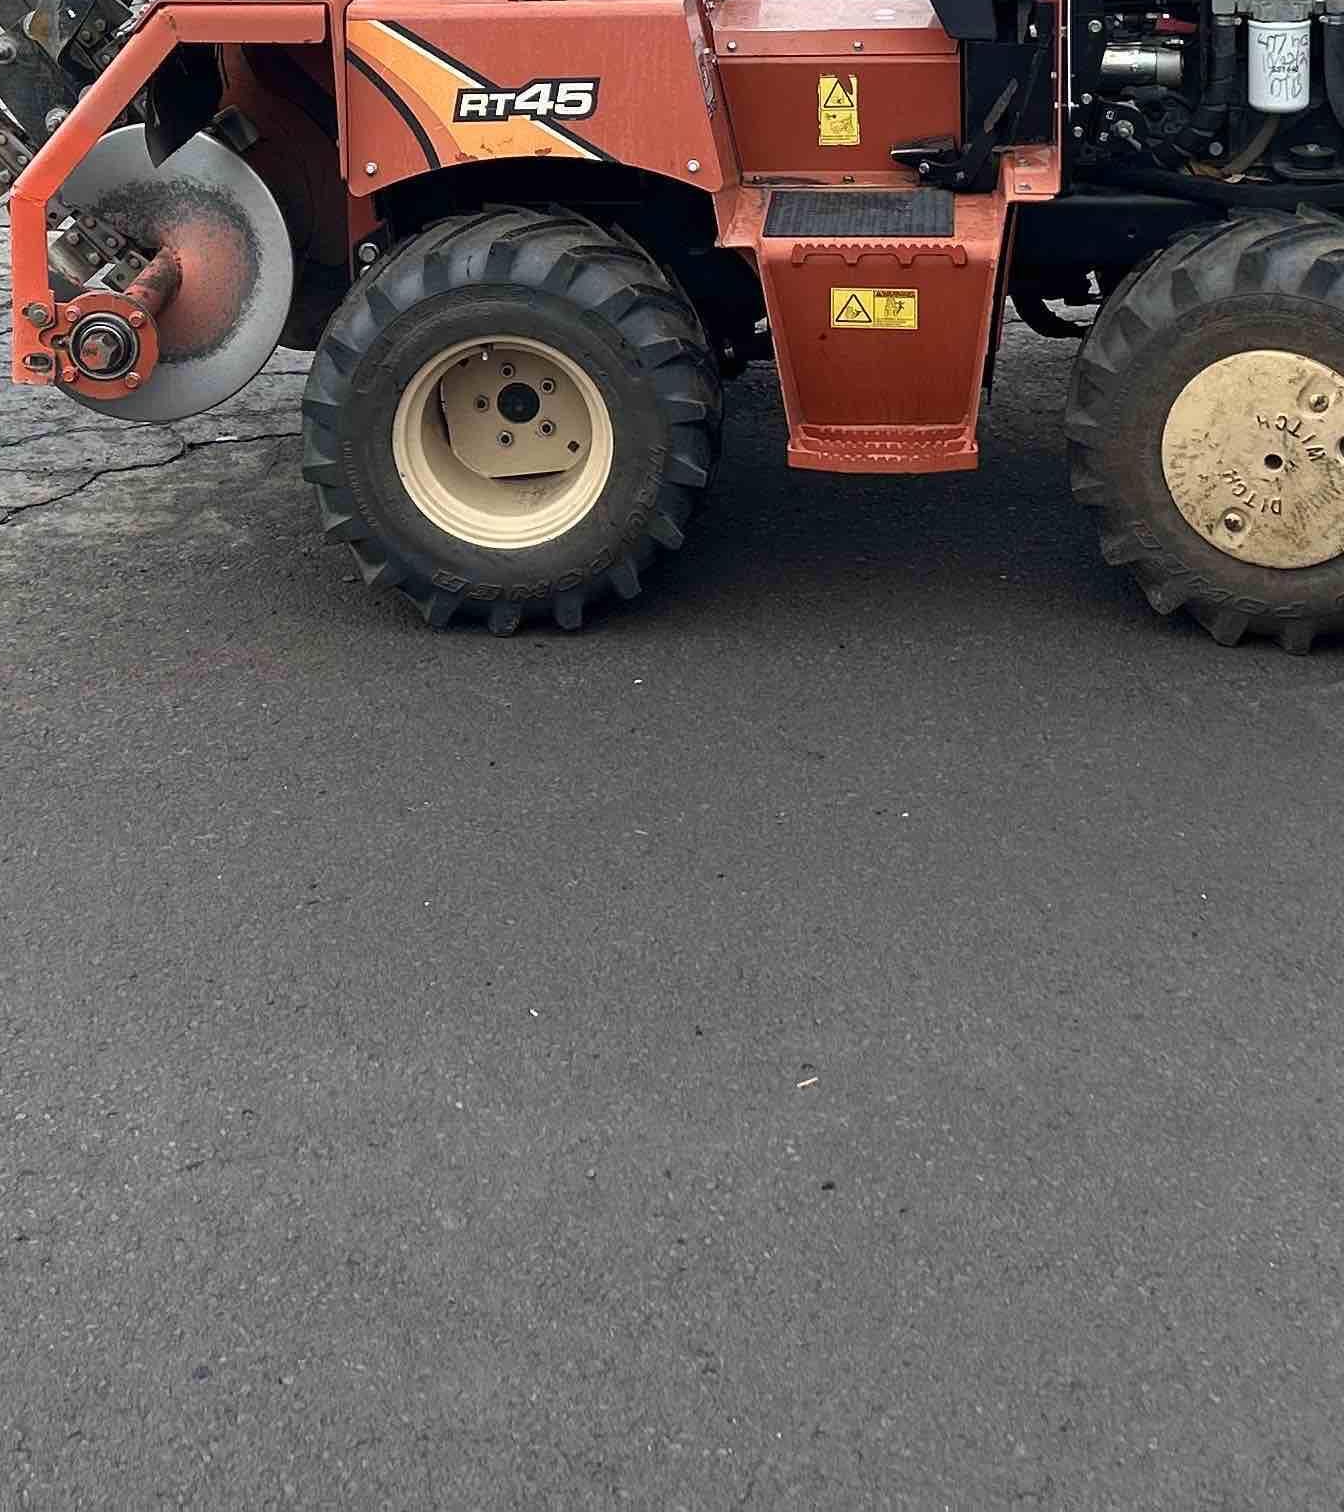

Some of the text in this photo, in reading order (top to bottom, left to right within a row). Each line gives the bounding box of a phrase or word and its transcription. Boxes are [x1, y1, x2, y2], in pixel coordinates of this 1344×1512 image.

[459, 82, 595, 118] RT45
[1256, 413, 1327, 462] WITCH
[1219, 469, 1283, 516] DITCH
